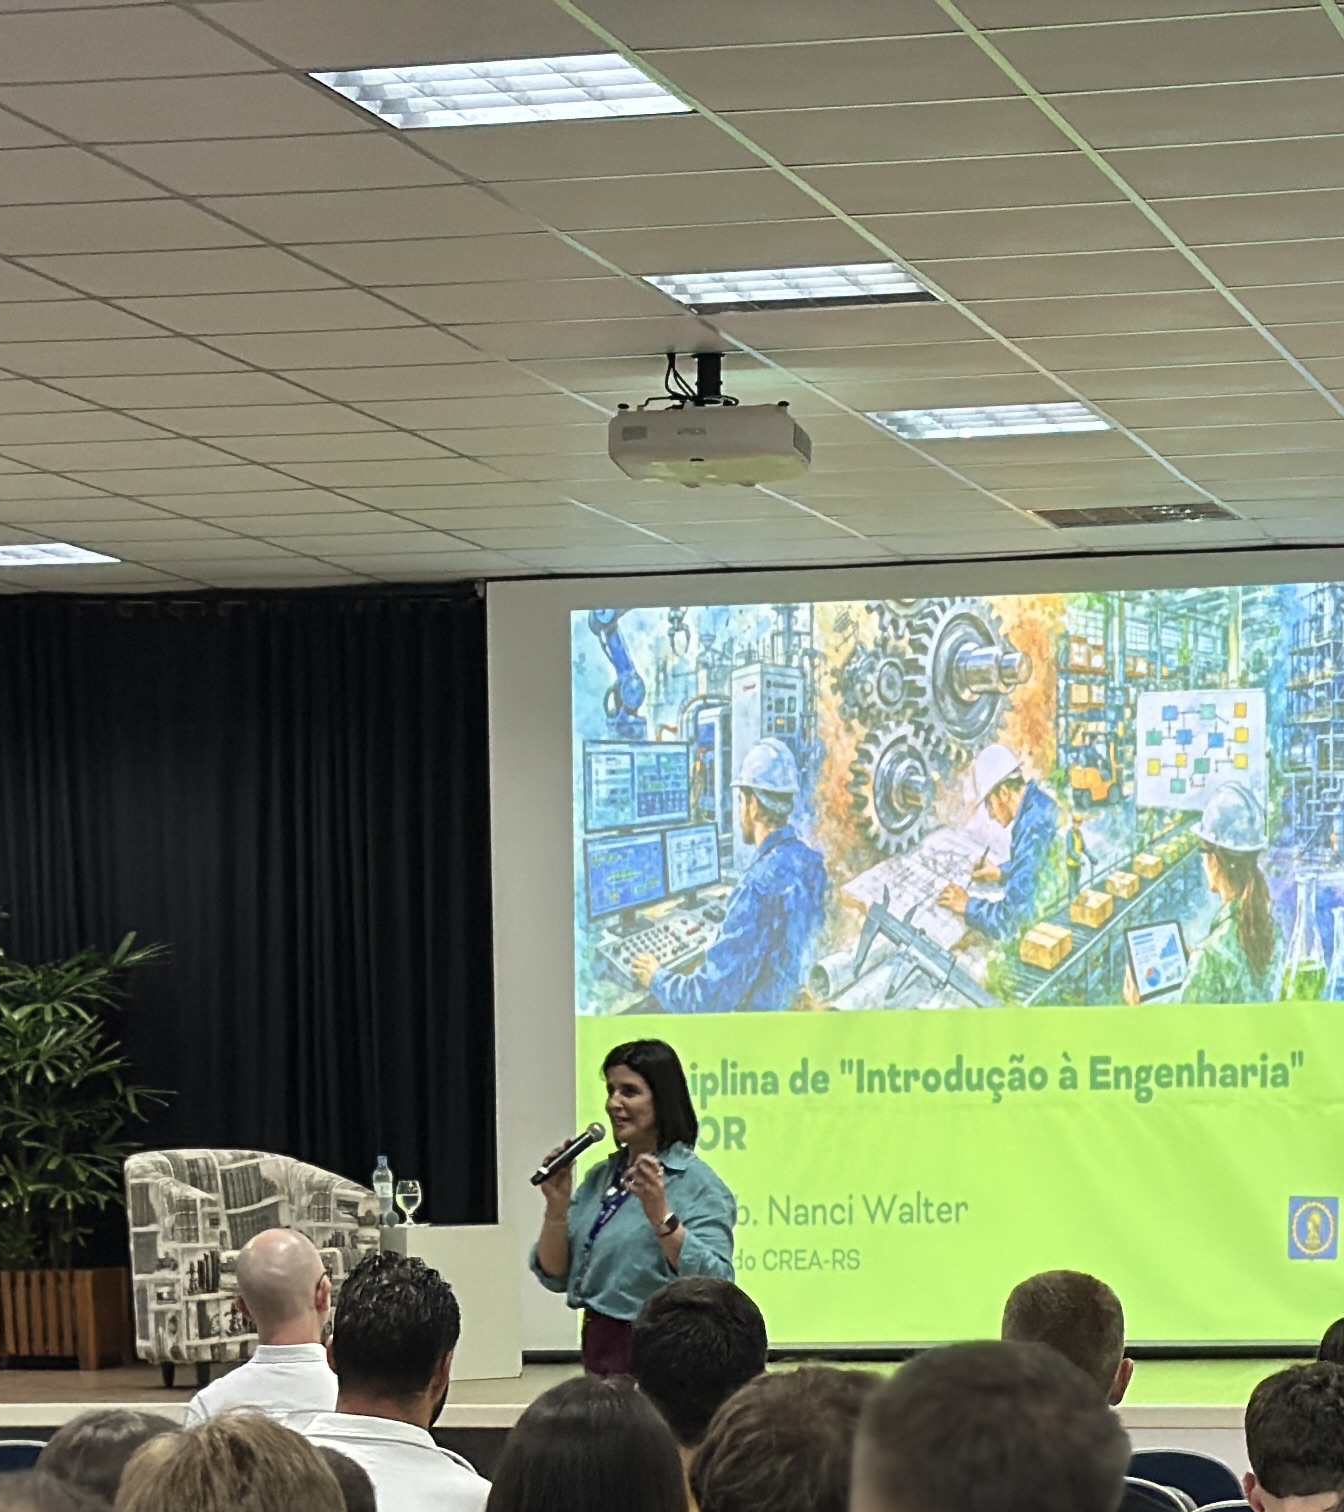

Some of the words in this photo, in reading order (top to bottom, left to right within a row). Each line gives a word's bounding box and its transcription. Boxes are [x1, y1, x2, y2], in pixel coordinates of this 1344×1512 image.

[789, 1057, 830, 1095] de
[840, 1053, 1048, 1104] "Introdução
[1059, 1051, 1078, 1091] à
[1089, 1049, 1304, 1104] Engenharia"
[768, 1194, 854, 1226] Nanci
[862, 1191, 968, 1225] Walter
[762, 1249, 861, 1271] CREA-RS
